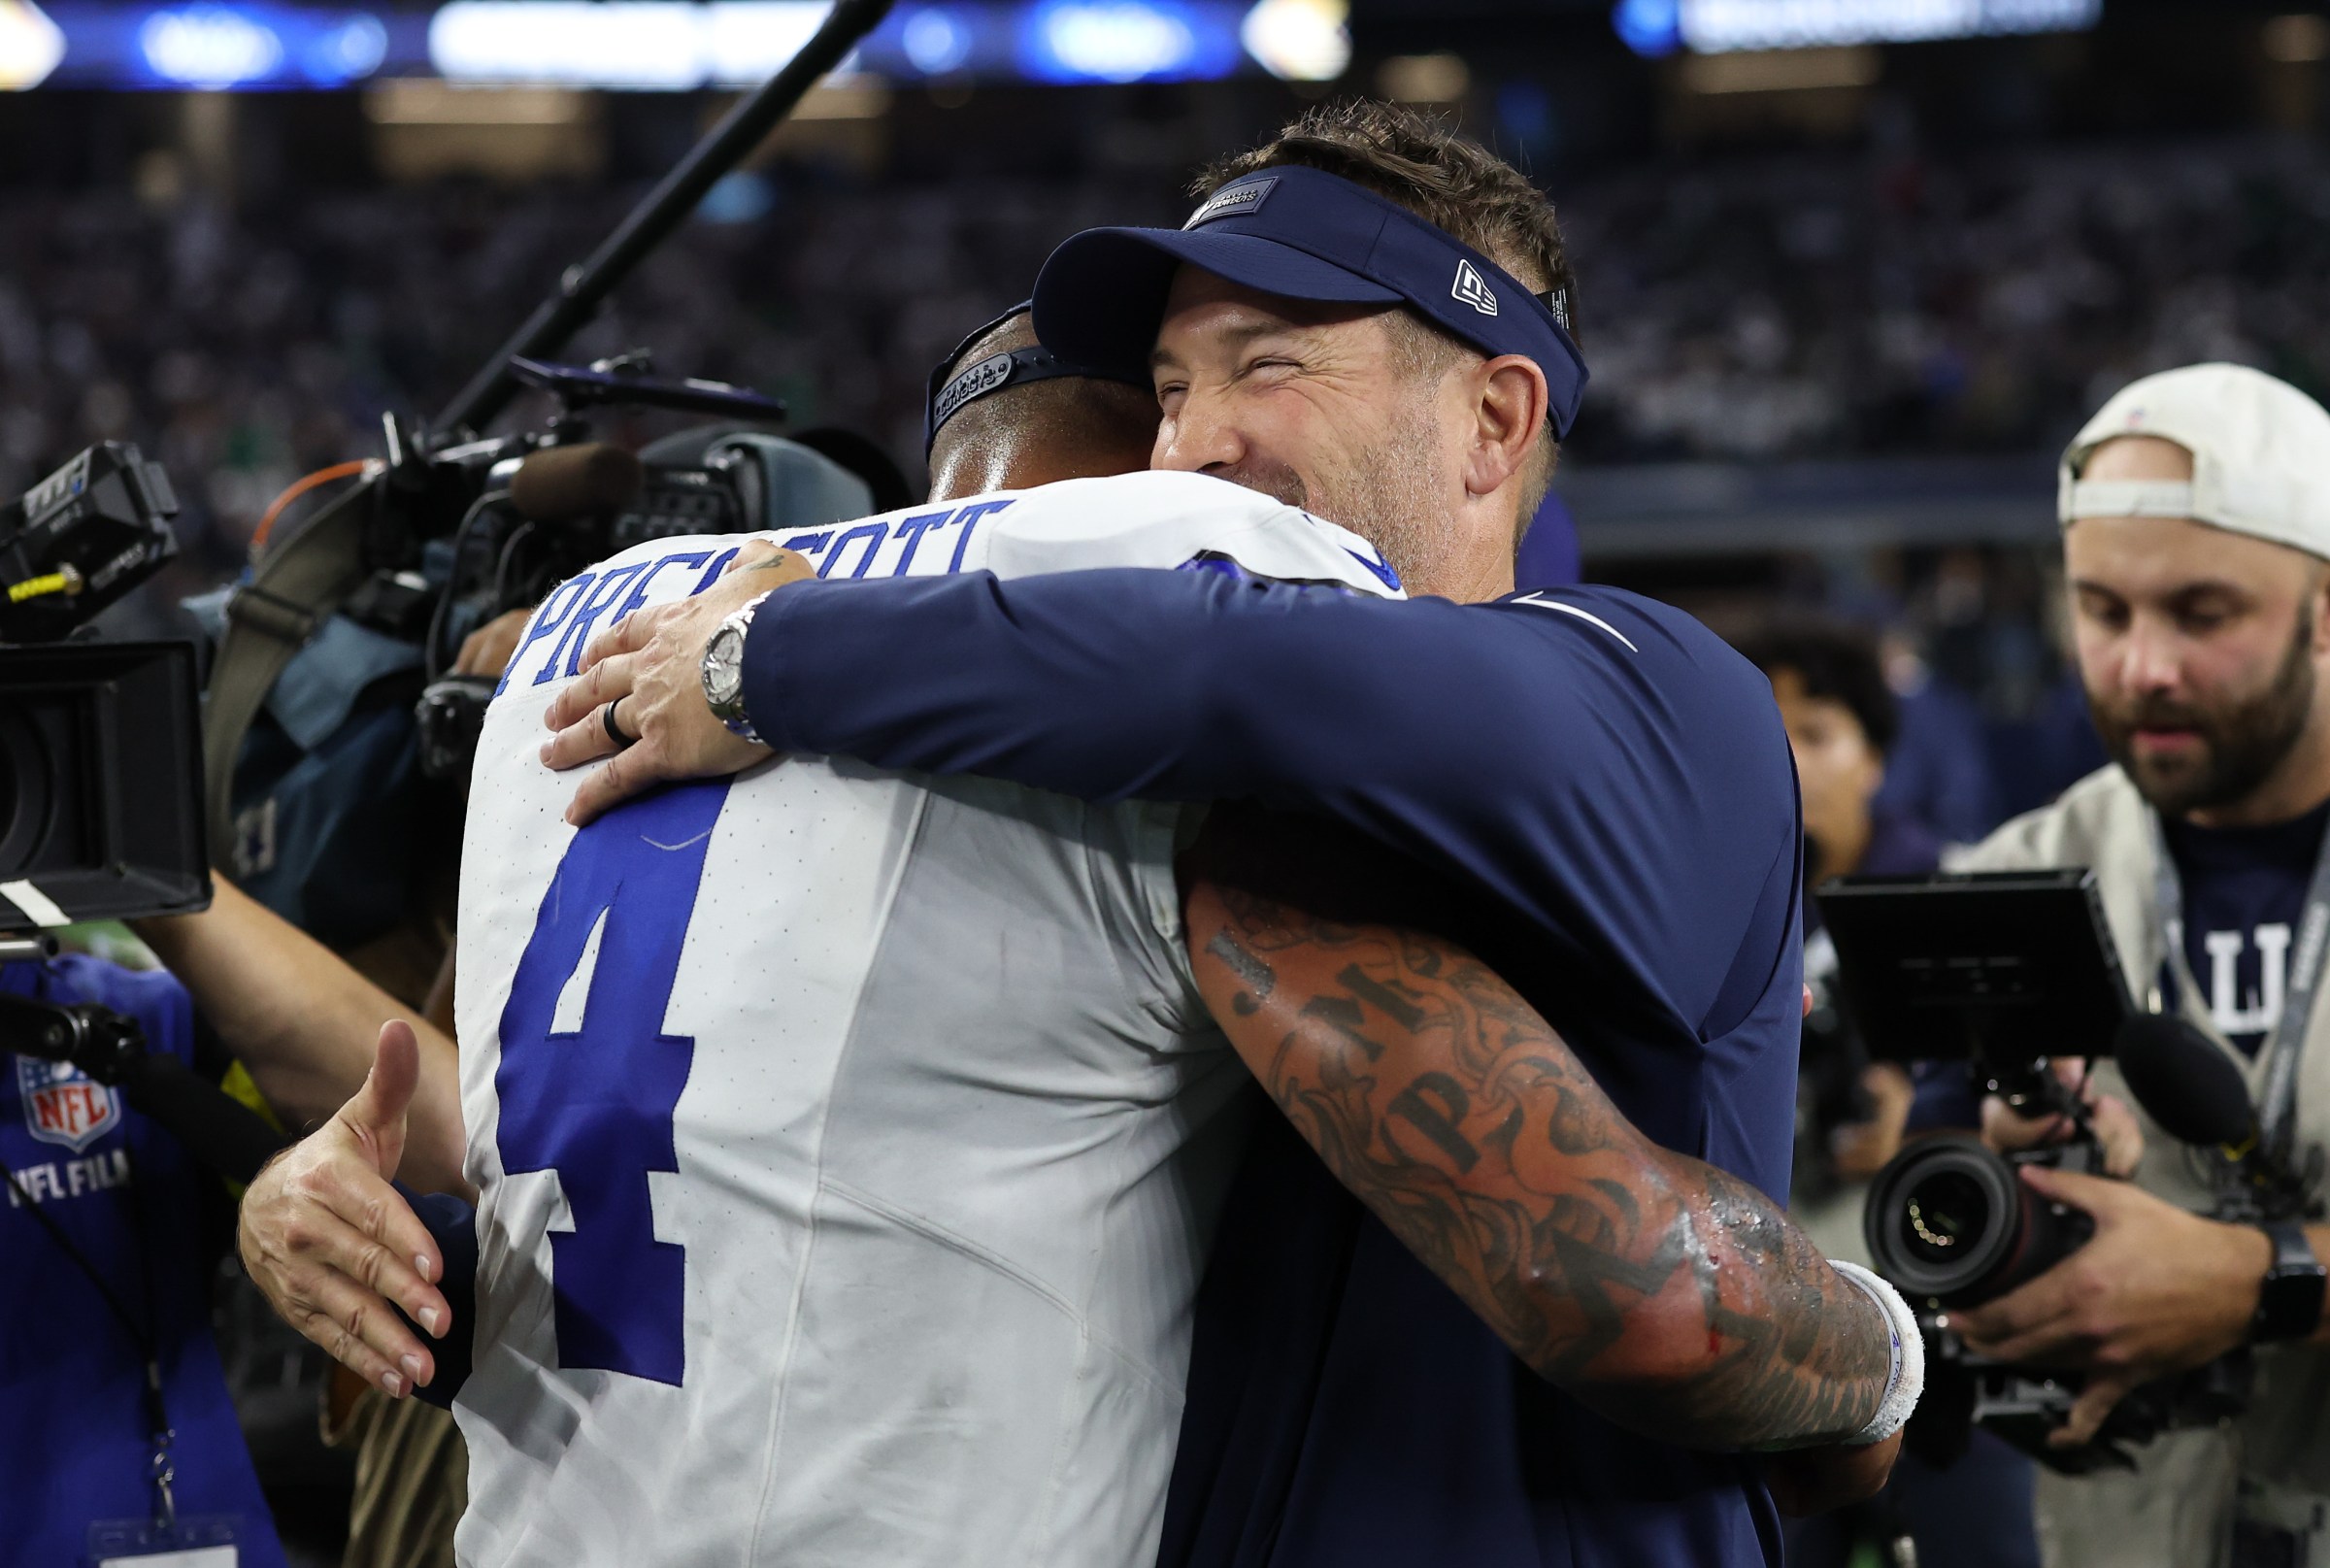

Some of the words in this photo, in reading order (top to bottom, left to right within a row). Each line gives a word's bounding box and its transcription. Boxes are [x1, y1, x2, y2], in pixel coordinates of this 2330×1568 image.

[1212, 193, 1257, 211] COWBOYS
[492, 500, 1016, 699] PREOTT
[34, 1084, 107, 1134] NFL
[494, 773, 737, 1387] 4
